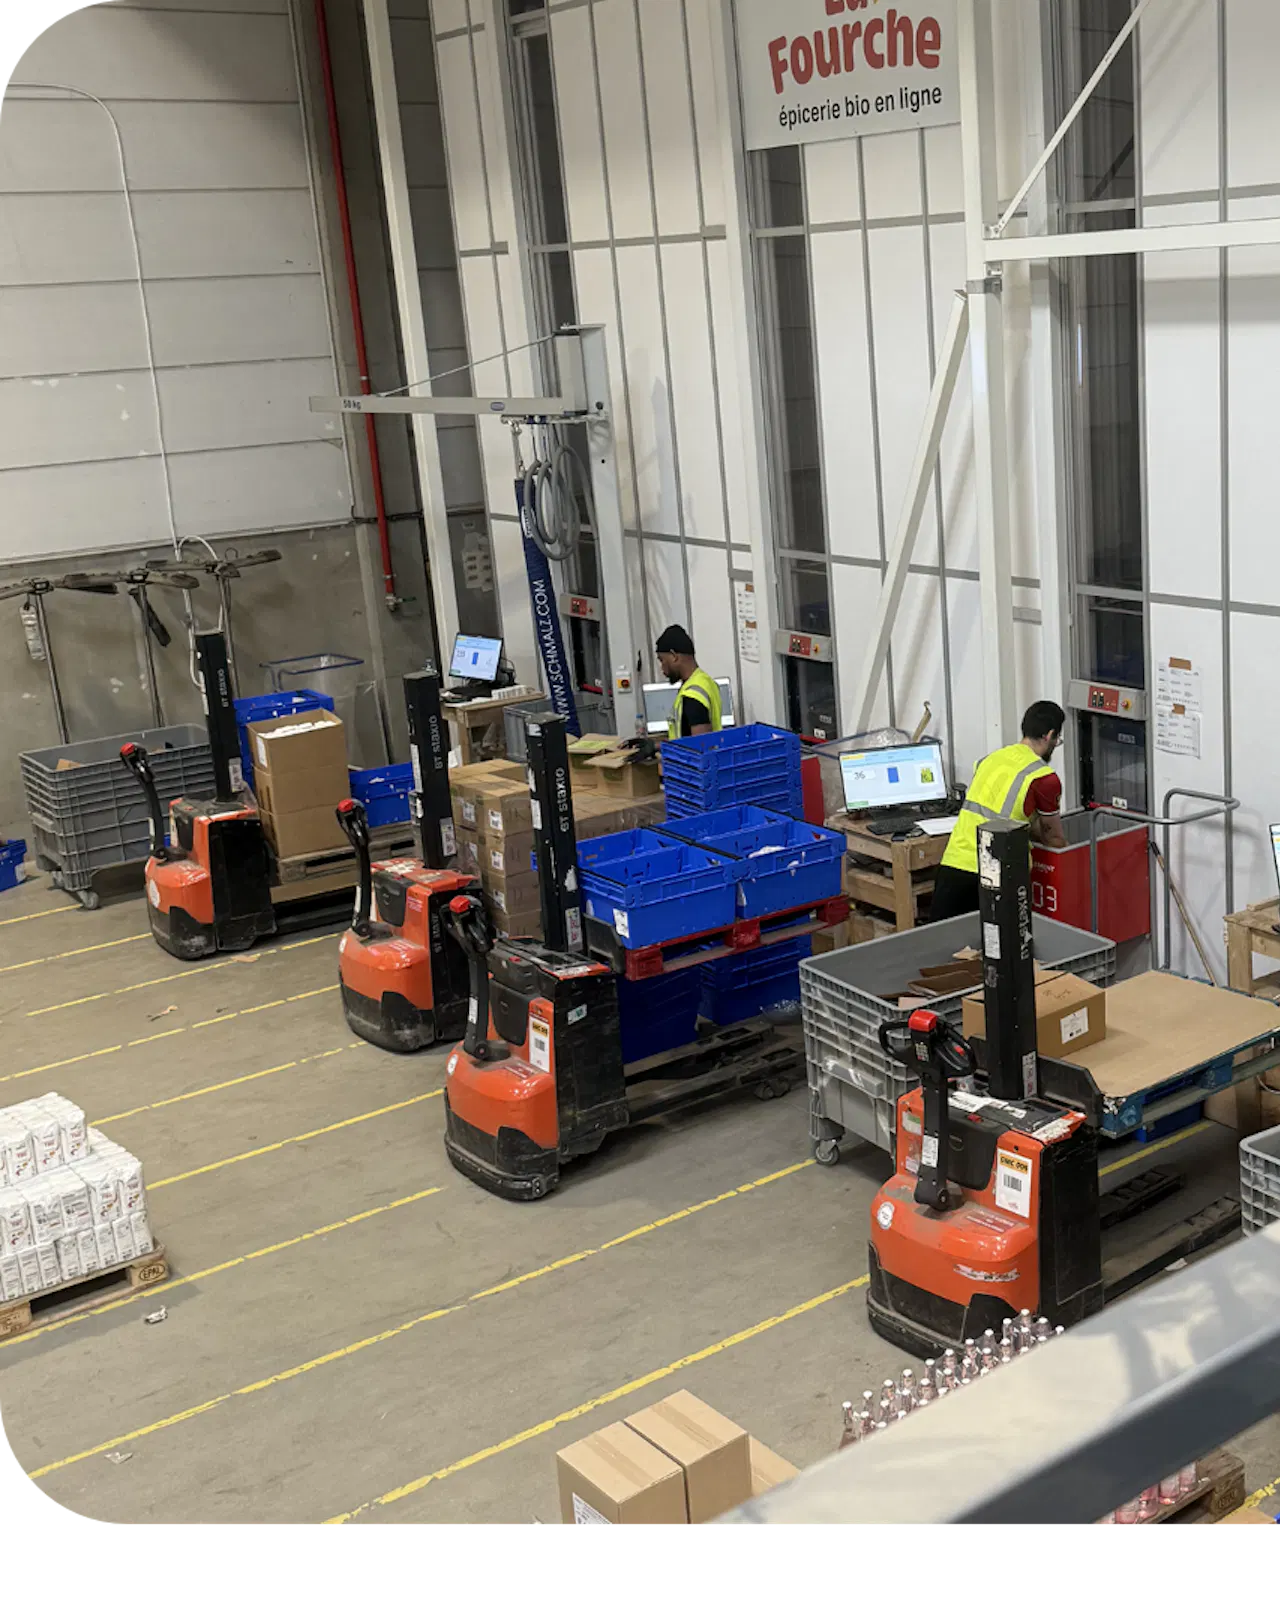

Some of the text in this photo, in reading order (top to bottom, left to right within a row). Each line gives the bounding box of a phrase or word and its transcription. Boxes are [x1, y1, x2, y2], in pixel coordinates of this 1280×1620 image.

[768, 9, 941, 94] Fourche
[779, 86, 942, 130] épicerie bio en ligne
[428, 714, 442, 752] staxio
[555, 767, 569, 832] BT staxio
